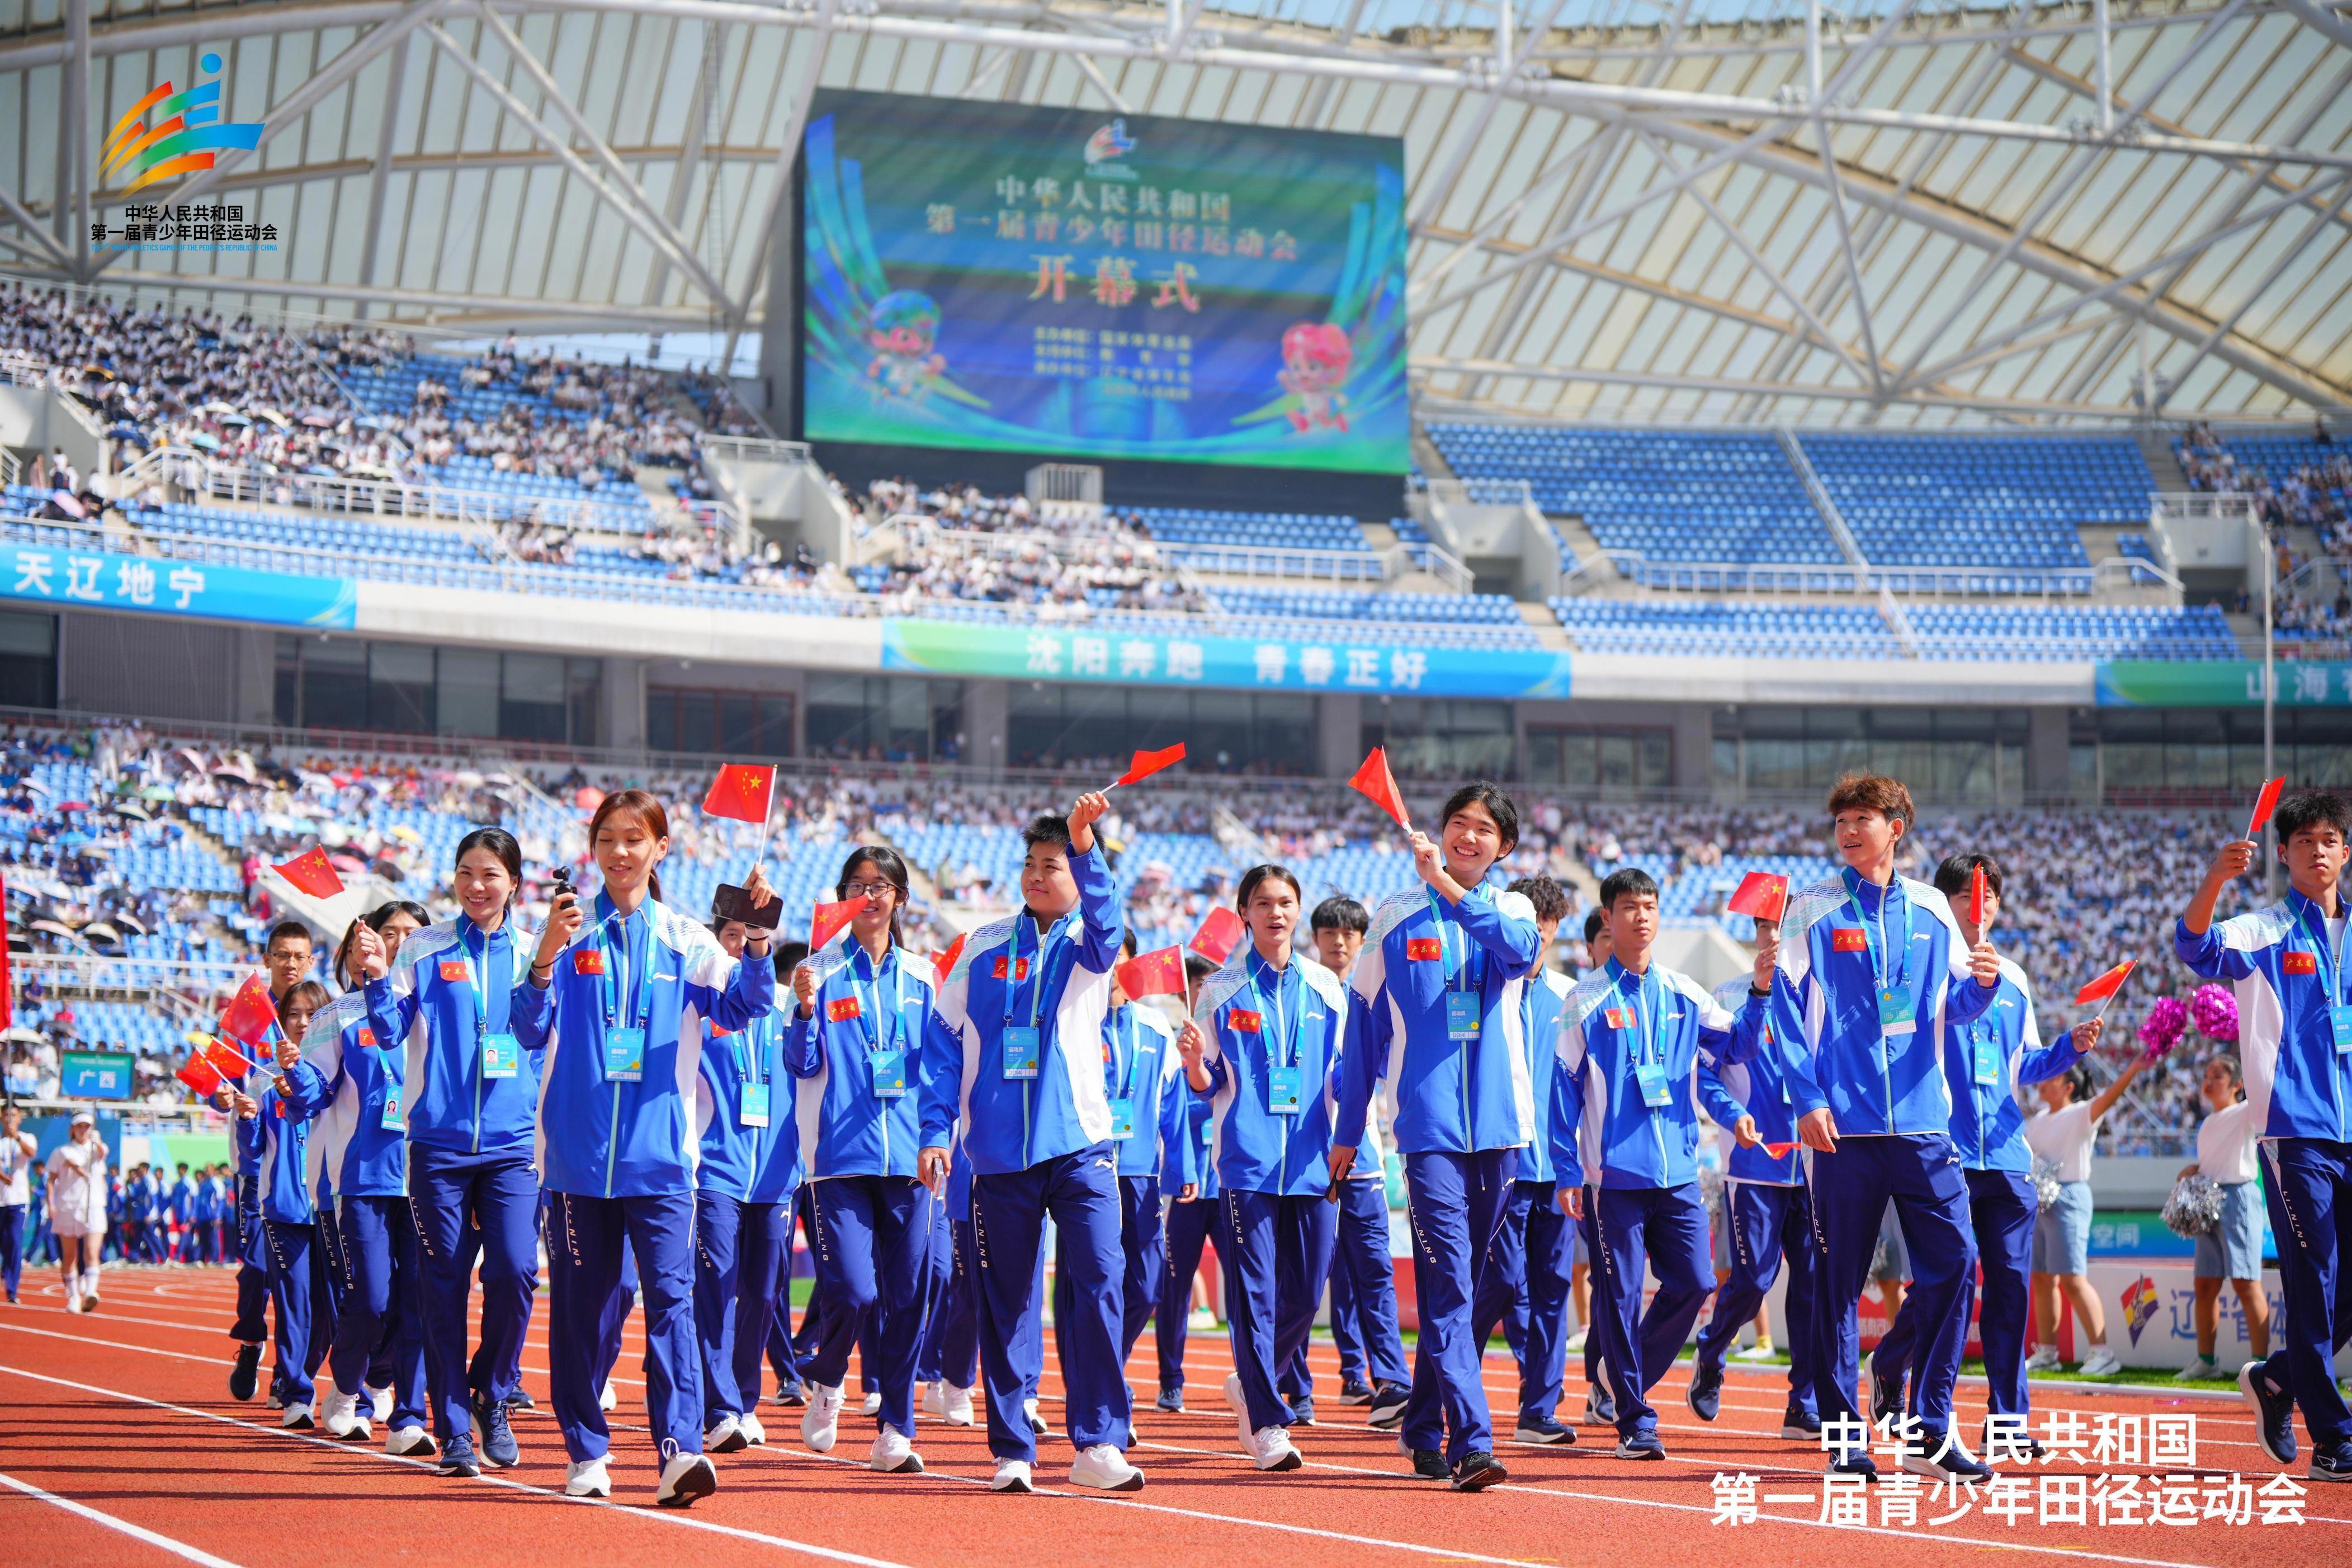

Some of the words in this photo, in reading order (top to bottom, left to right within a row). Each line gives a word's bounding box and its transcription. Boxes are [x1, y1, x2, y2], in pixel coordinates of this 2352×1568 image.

[996, 174, 1230, 221] 中华人民共和国
[925, 203, 1297, 261] 第一届青少年田径运动会
[1027, 253, 1201, 313] 开幕式
[14, 551, 206, 609] 天辽地宁
[1025, 633, 1204, 681] 沈阳奔跑
[1253, 643, 1428, 690] 青春正好
[1410, 944, 1437, 955] 广东省
[1837, 935, 1862, 944] 广东省
[2287, 958, 2312, 967] 广东省
[998, 963, 1024, 974] 广省
[831, 1003, 856, 1016] 广东省
[1232, 1015, 1257, 1026] 广东省
[78, 1069, 116, 1089] 广西
[321, 1215, 337, 1267] LI-NING
[411, 1196, 434, 1256] LI-NING
[566, 1201, 582, 1266] LI-NING
[816, 1205, 829, 1262] LI-NING
[975, 1203, 988, 1268] LI-NING
[1231, 1188, 1243, 1244] I-NING
[1411, 1206, 1437, 1264] LI-NING
[1735, 1215, 1747, 1265] LI-NING
[2092, 1222, 2140, 1249] 空间
[2283, 1191, 2307, 1248] LI-NING
[268, 1224, 287, 1269] LI-NING
[341, 1235, 353, 1290] LI-NING
[1599, 1219, 1611, 1275] LI-NING
[2170, 1289, 2287, 1343] 辽省体
